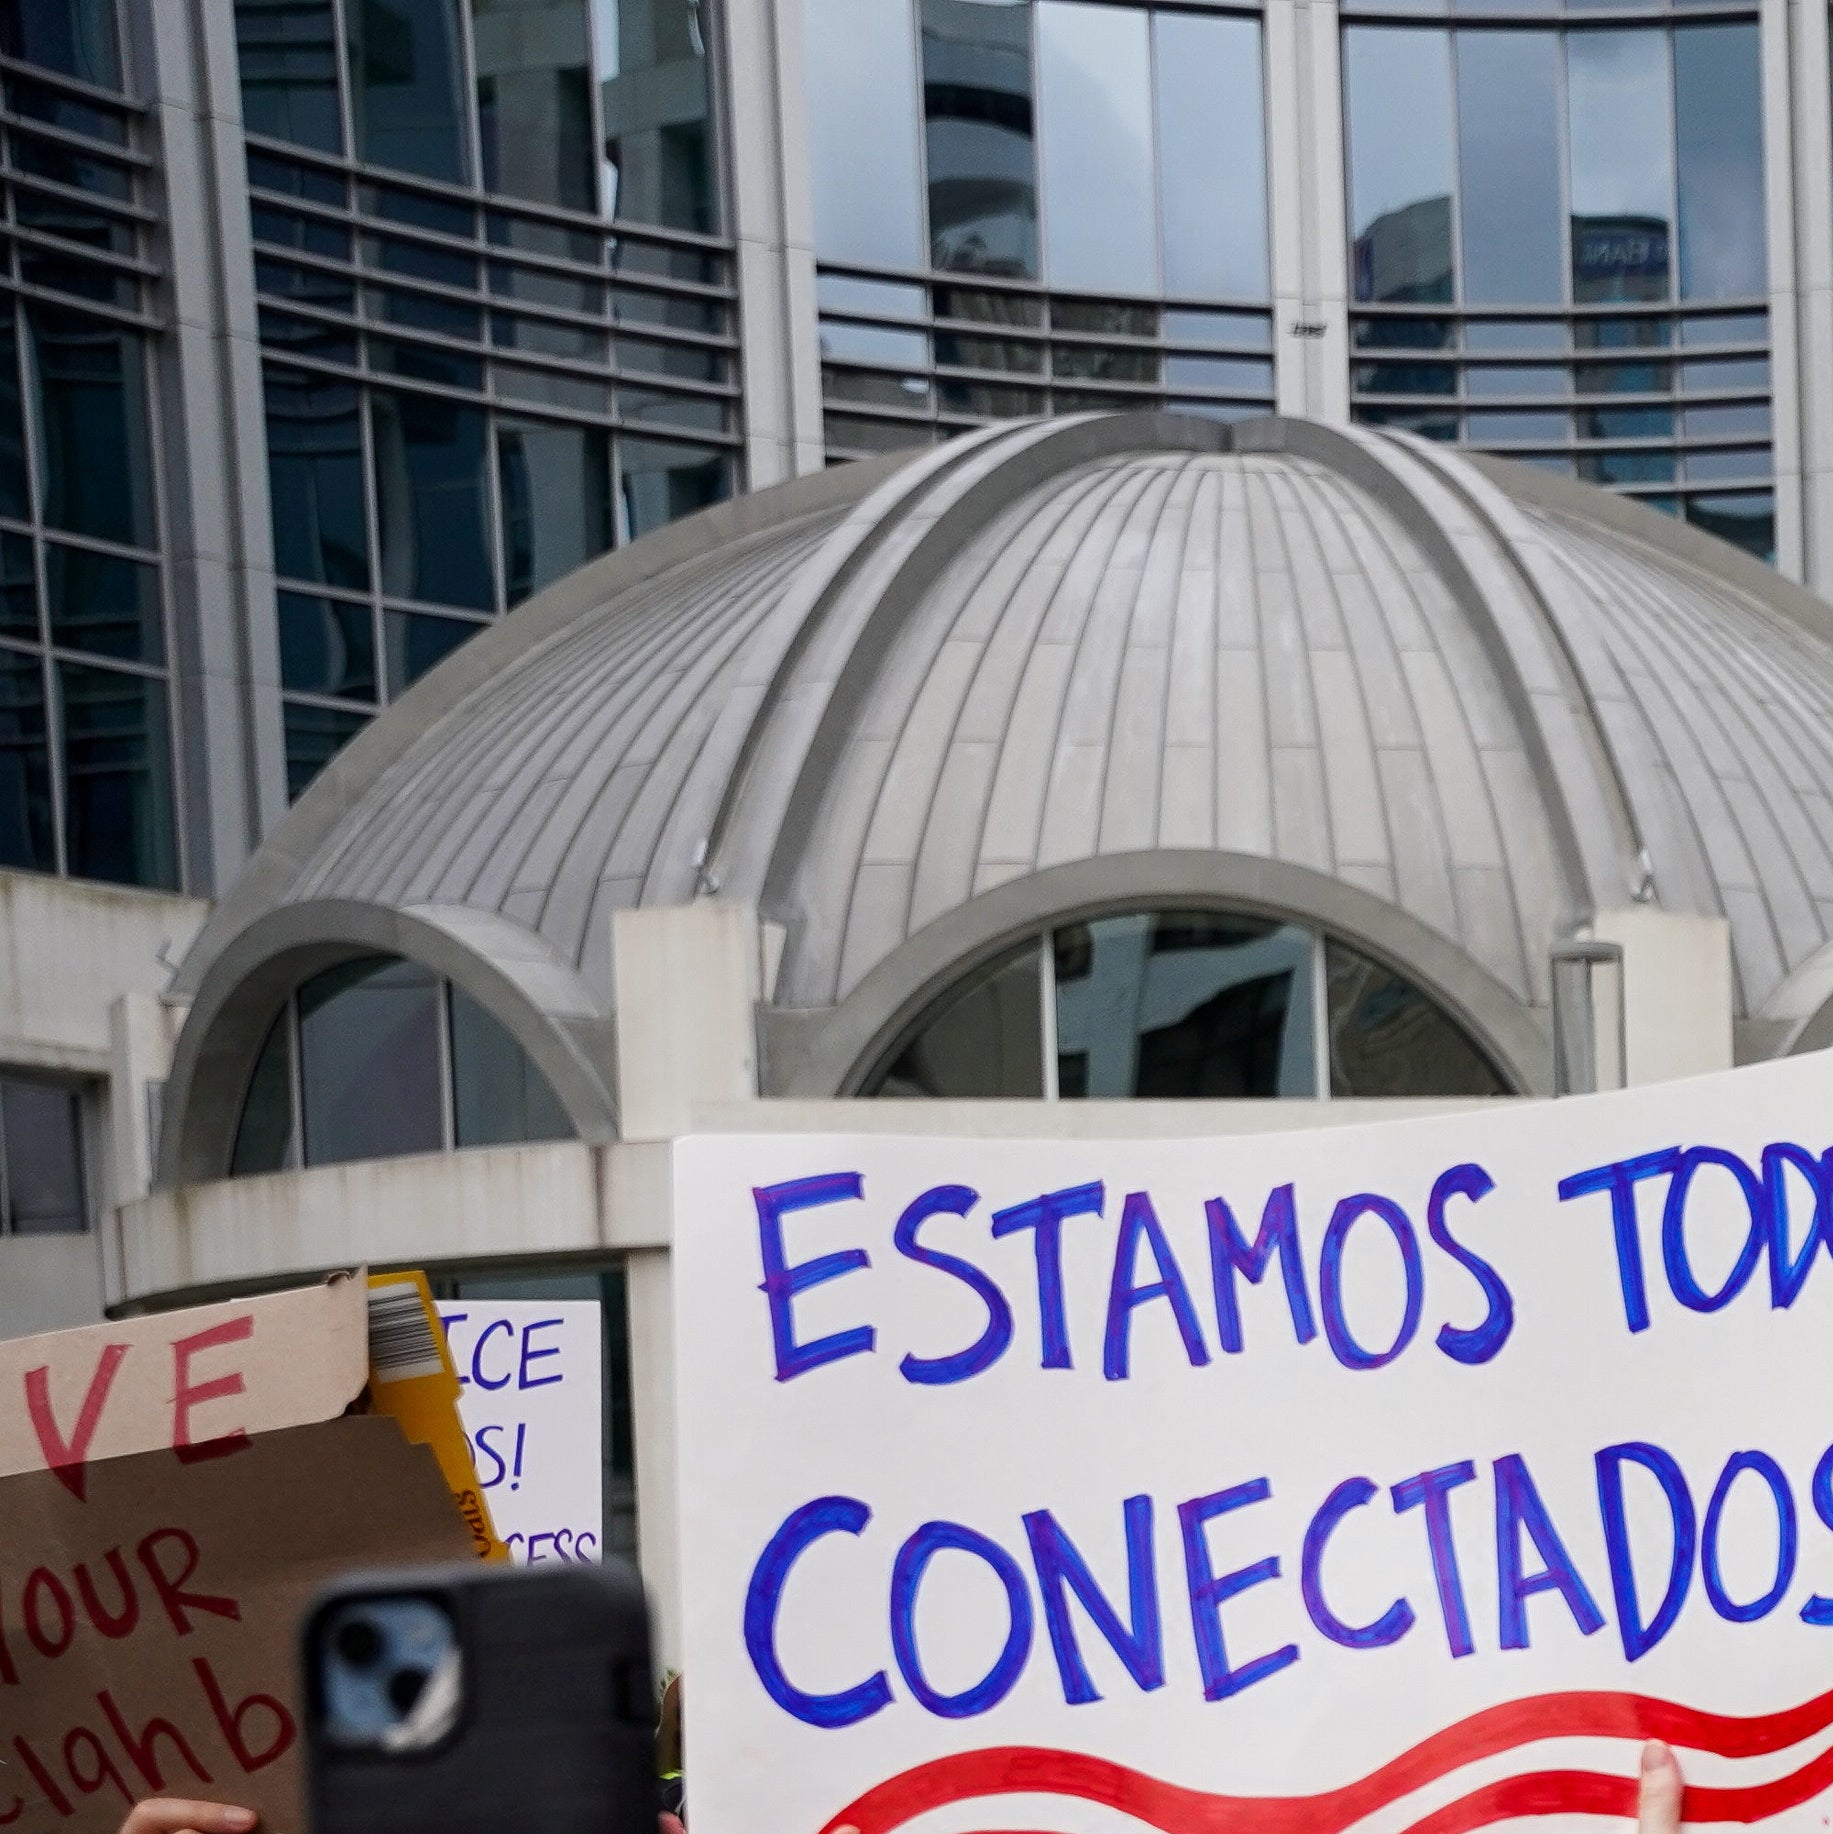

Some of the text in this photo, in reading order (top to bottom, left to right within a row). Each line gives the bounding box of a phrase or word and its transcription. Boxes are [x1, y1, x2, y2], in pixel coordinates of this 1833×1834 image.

[753, 1163, 1515, 1386] ESTAMOS
[462, 1423, 526, 1491] S!
[0, 1527, 243, 1686] OUR
